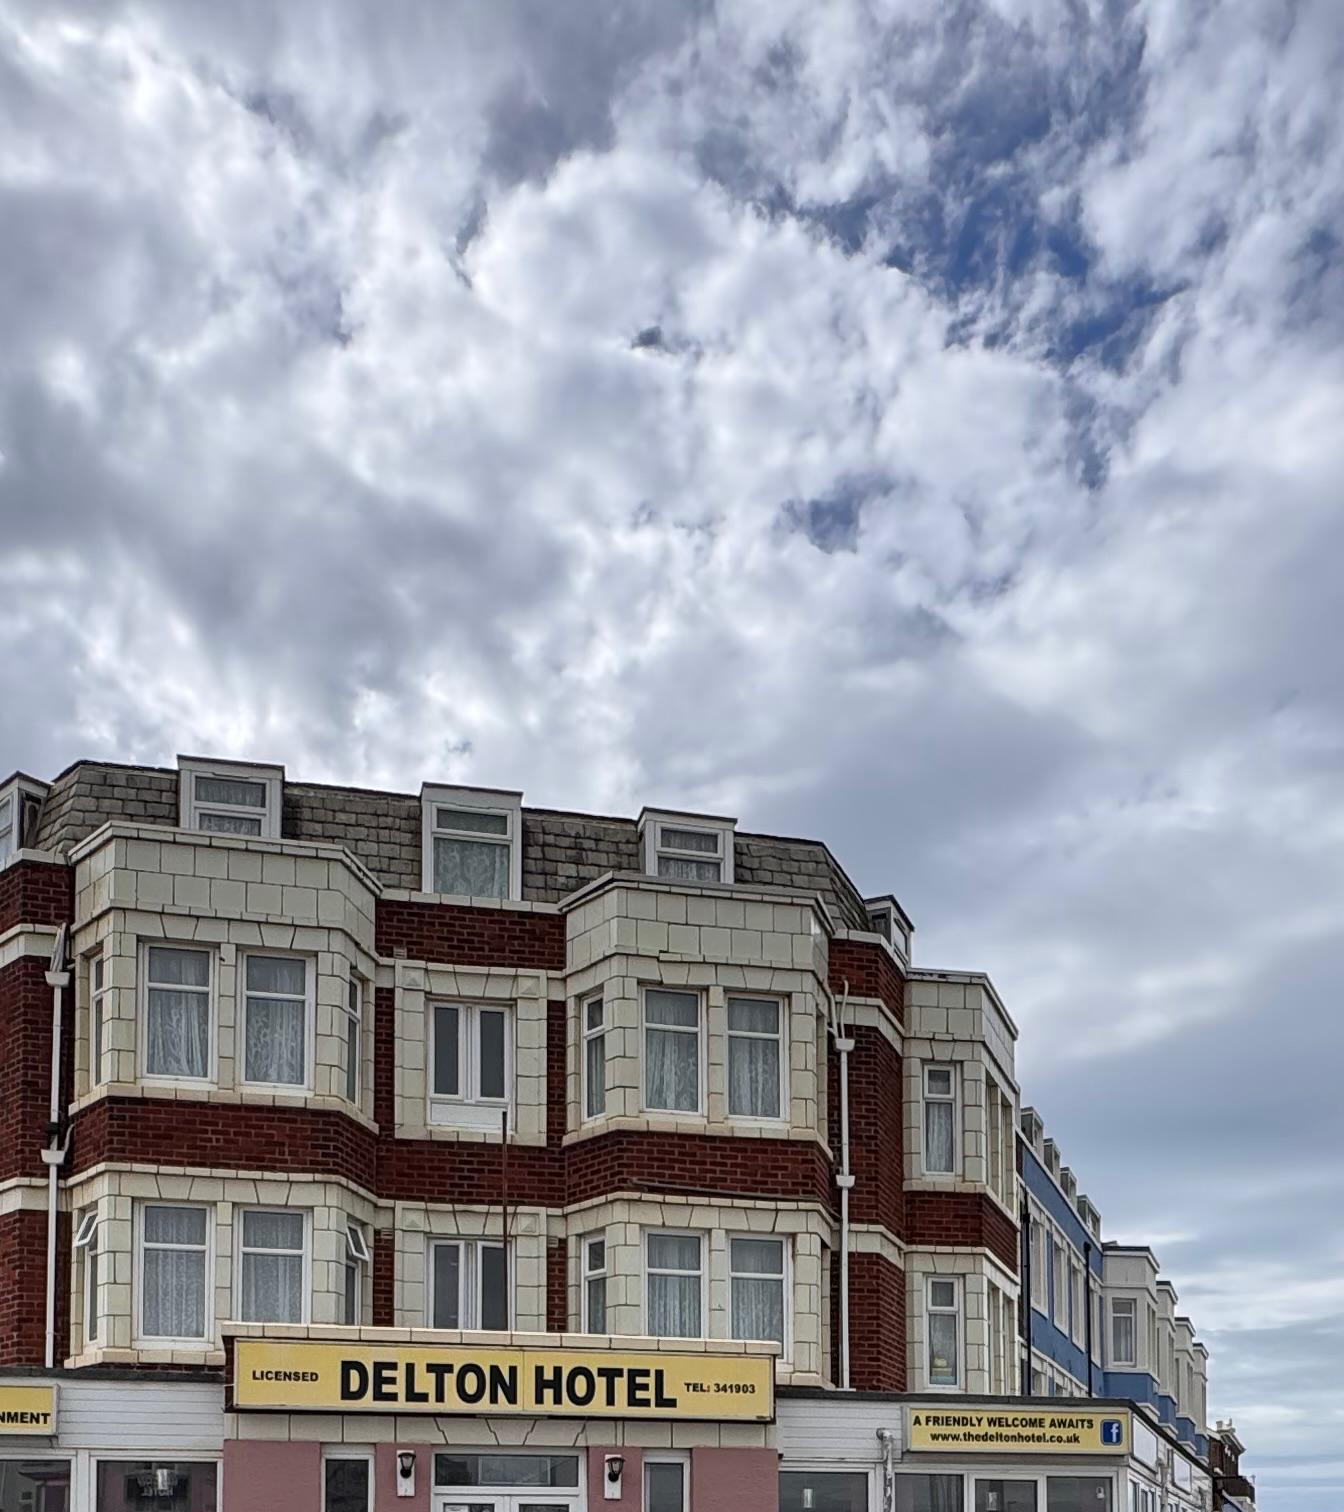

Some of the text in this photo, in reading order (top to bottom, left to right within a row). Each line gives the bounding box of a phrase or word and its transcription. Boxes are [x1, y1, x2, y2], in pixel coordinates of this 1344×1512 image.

[252, 1369, 319, 1382] LICENSED
[340, 1360, 678, 1408] DELTON HOTEL
[684, 1382, 756, 1395] TEL: 341903
[912, 1416, 1094, 1429] A FRIENDLY WELCOME AWAITS
[930, 1431, 1081, 1444] www.thedeltonhotel.co.uk
